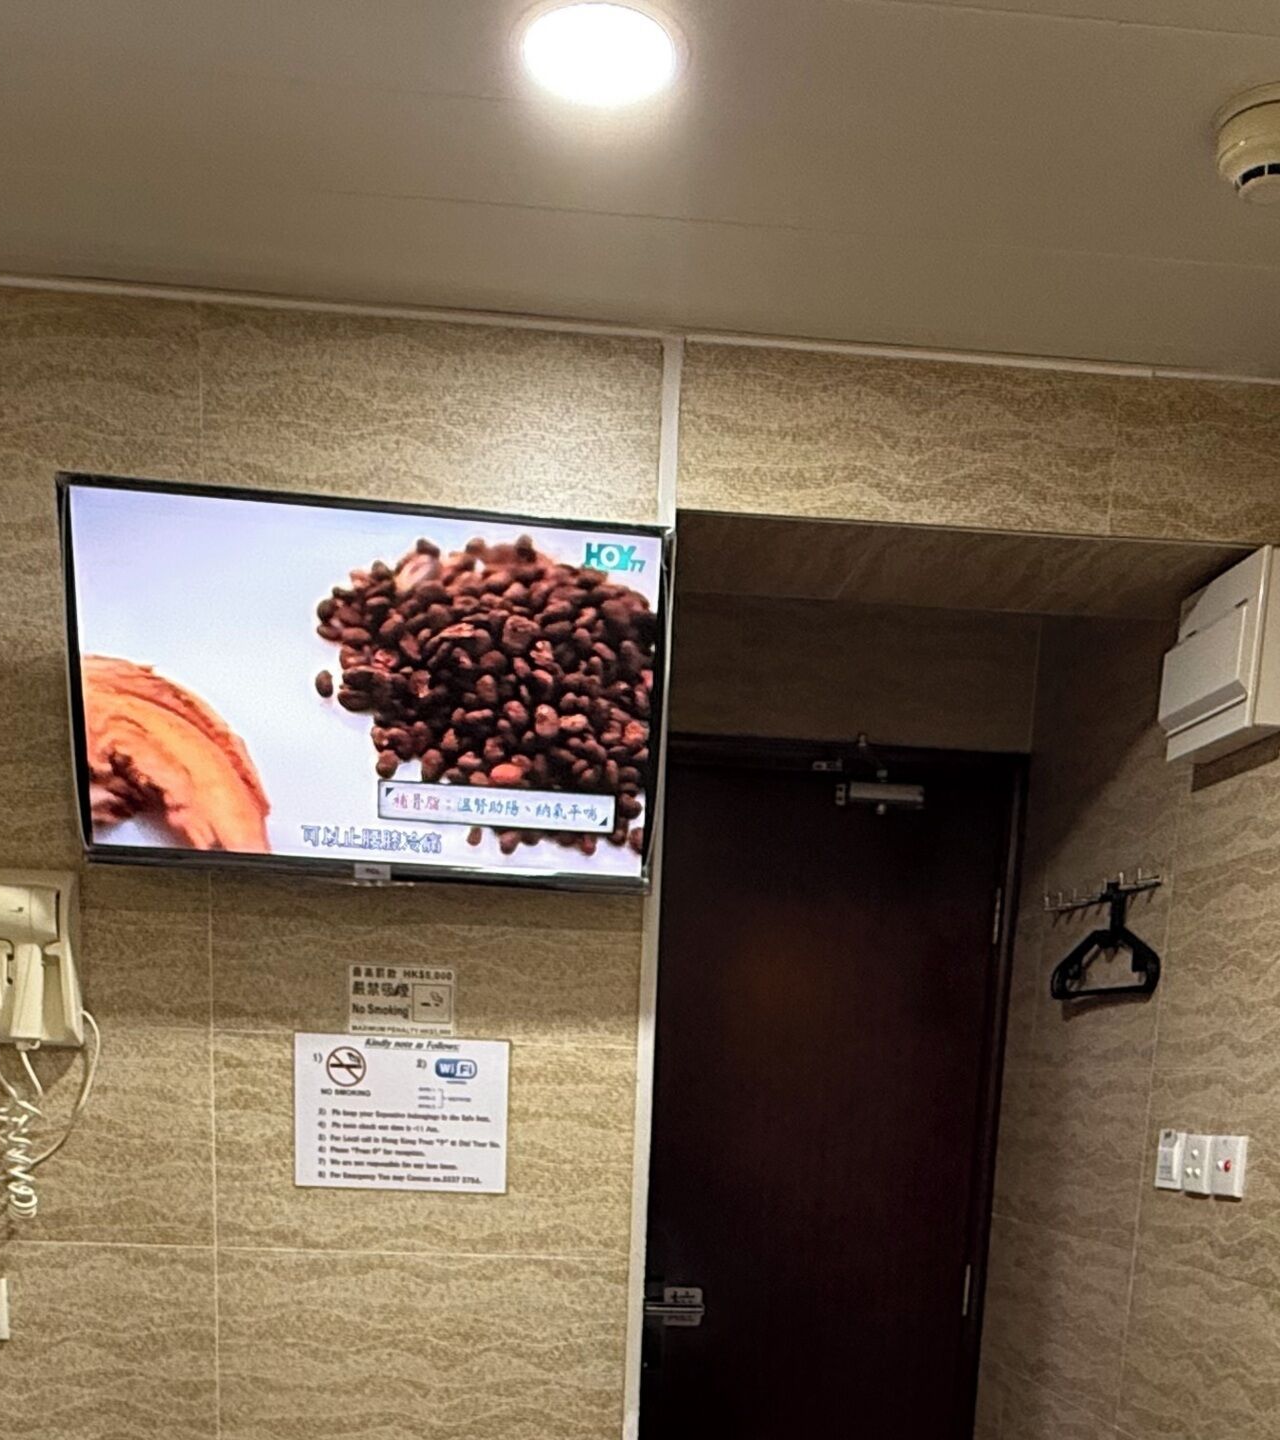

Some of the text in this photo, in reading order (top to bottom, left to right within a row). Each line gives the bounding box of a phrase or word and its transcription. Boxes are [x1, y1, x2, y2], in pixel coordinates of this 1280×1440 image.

[352, 1003, 409, 1019] No Smoking
[365, 1038, 392, 1049] Kindly
[334, 1089, 371, 1097] SMOKING
